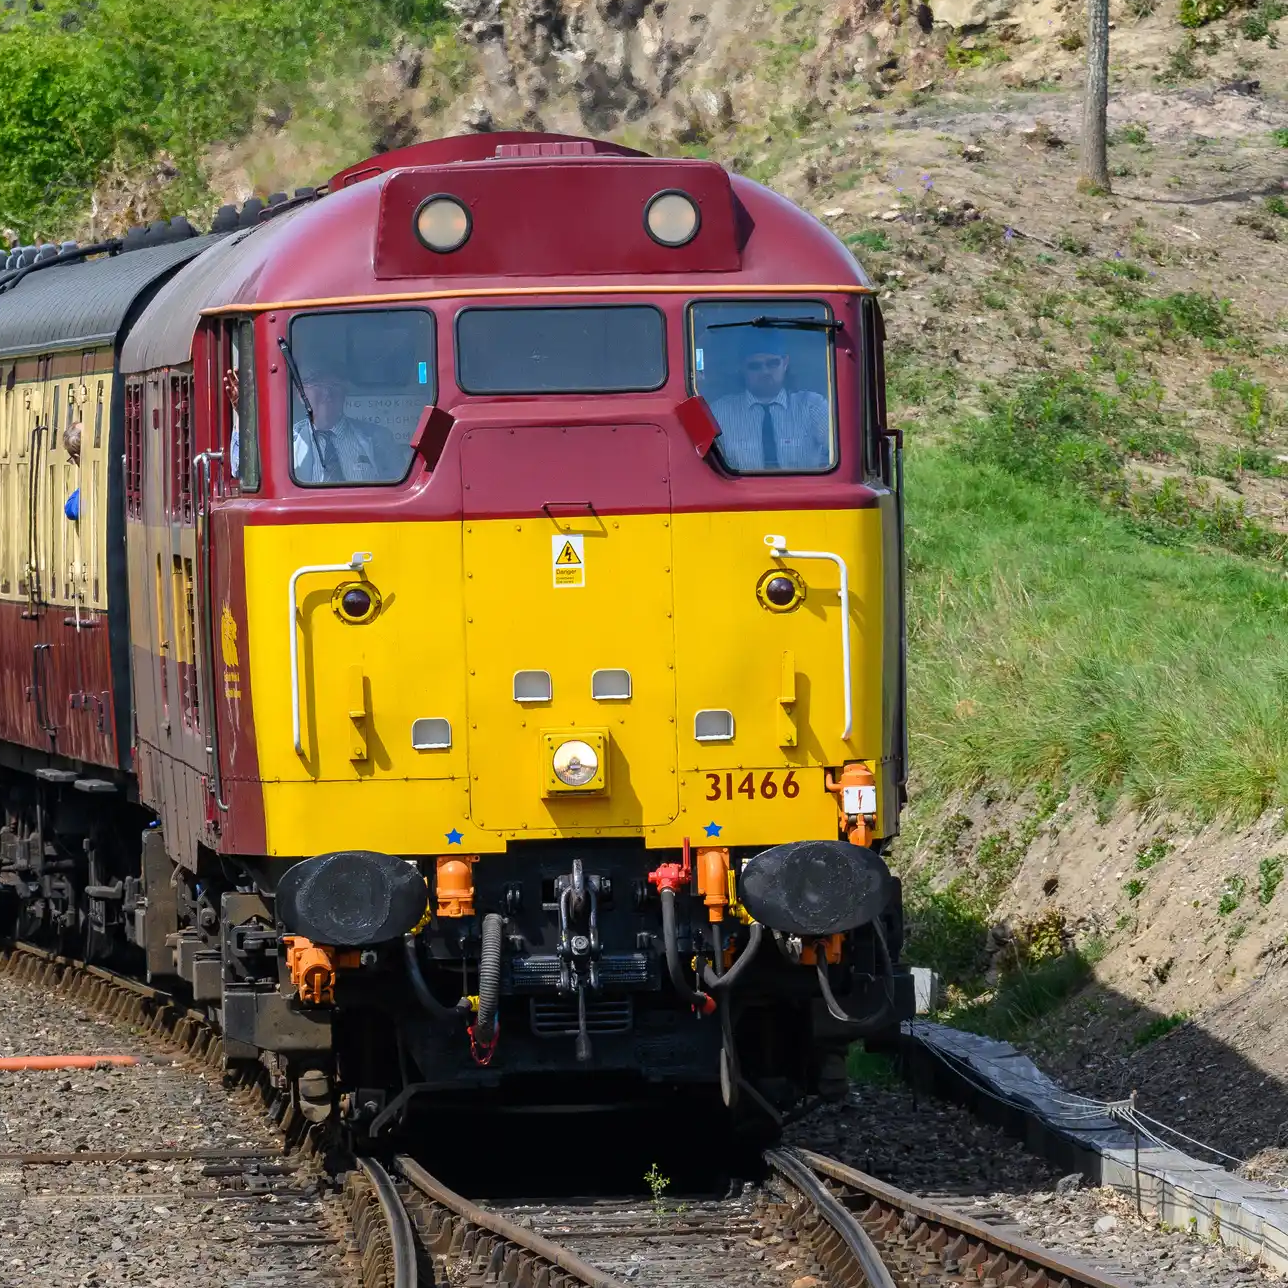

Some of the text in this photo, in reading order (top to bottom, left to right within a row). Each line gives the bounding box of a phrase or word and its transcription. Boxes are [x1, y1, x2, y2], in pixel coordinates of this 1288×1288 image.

[346, 399, 422, 409] NO SMOKING
[705, 770, 801, 802] 31466
